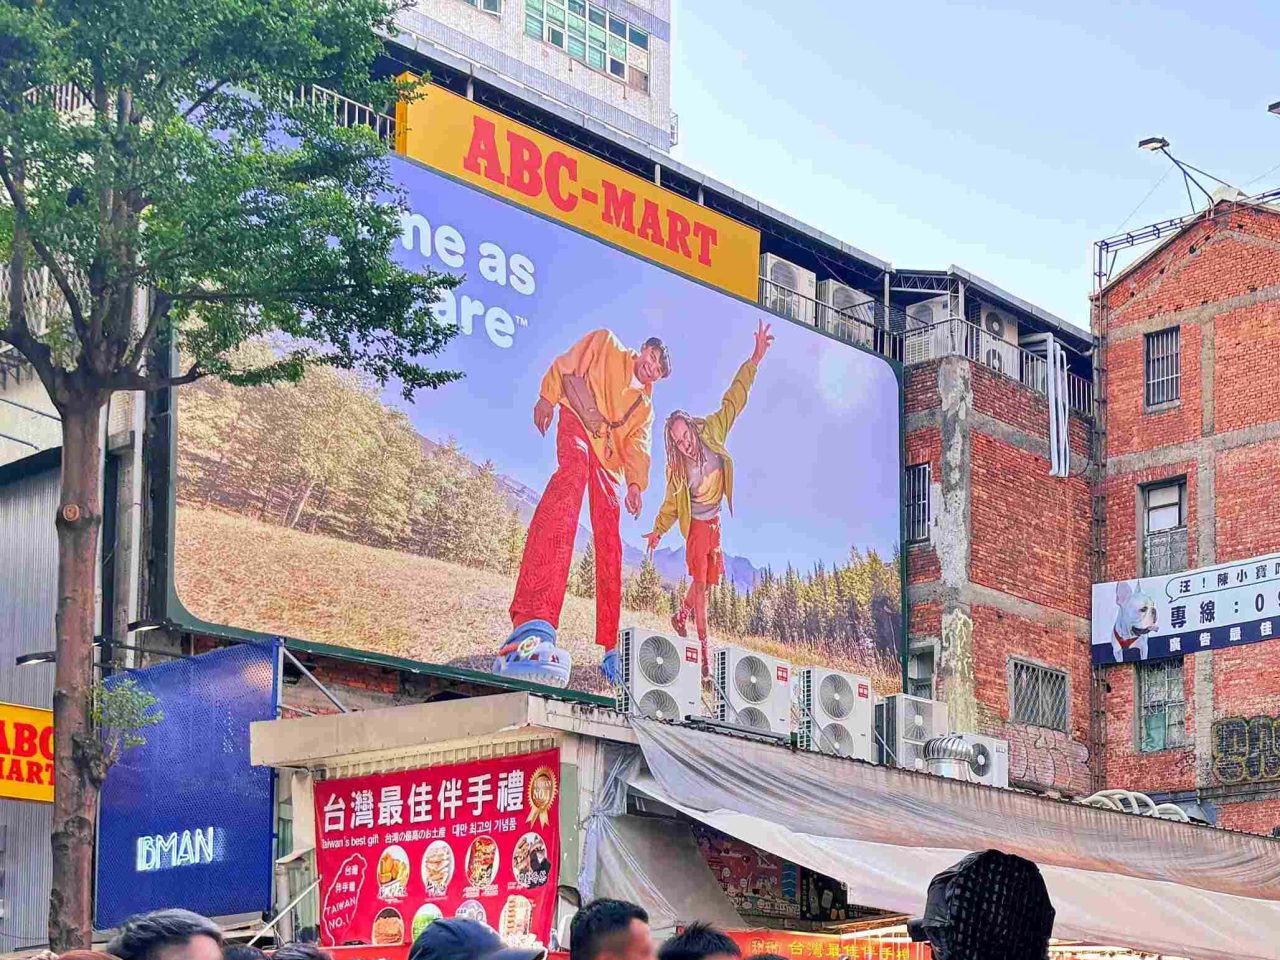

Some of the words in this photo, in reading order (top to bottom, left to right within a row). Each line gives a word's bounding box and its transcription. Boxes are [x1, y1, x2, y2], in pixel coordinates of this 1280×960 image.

[463, 115, 718, 267] ABC-MART
[478, 242, 536, 295] as
[0, 756, 55, 786] ART
[324, 769, 525, 833] 台灣最佳伴手禮
[351, 834, 367, 846] best
[367, 832, 379, 847] gift
